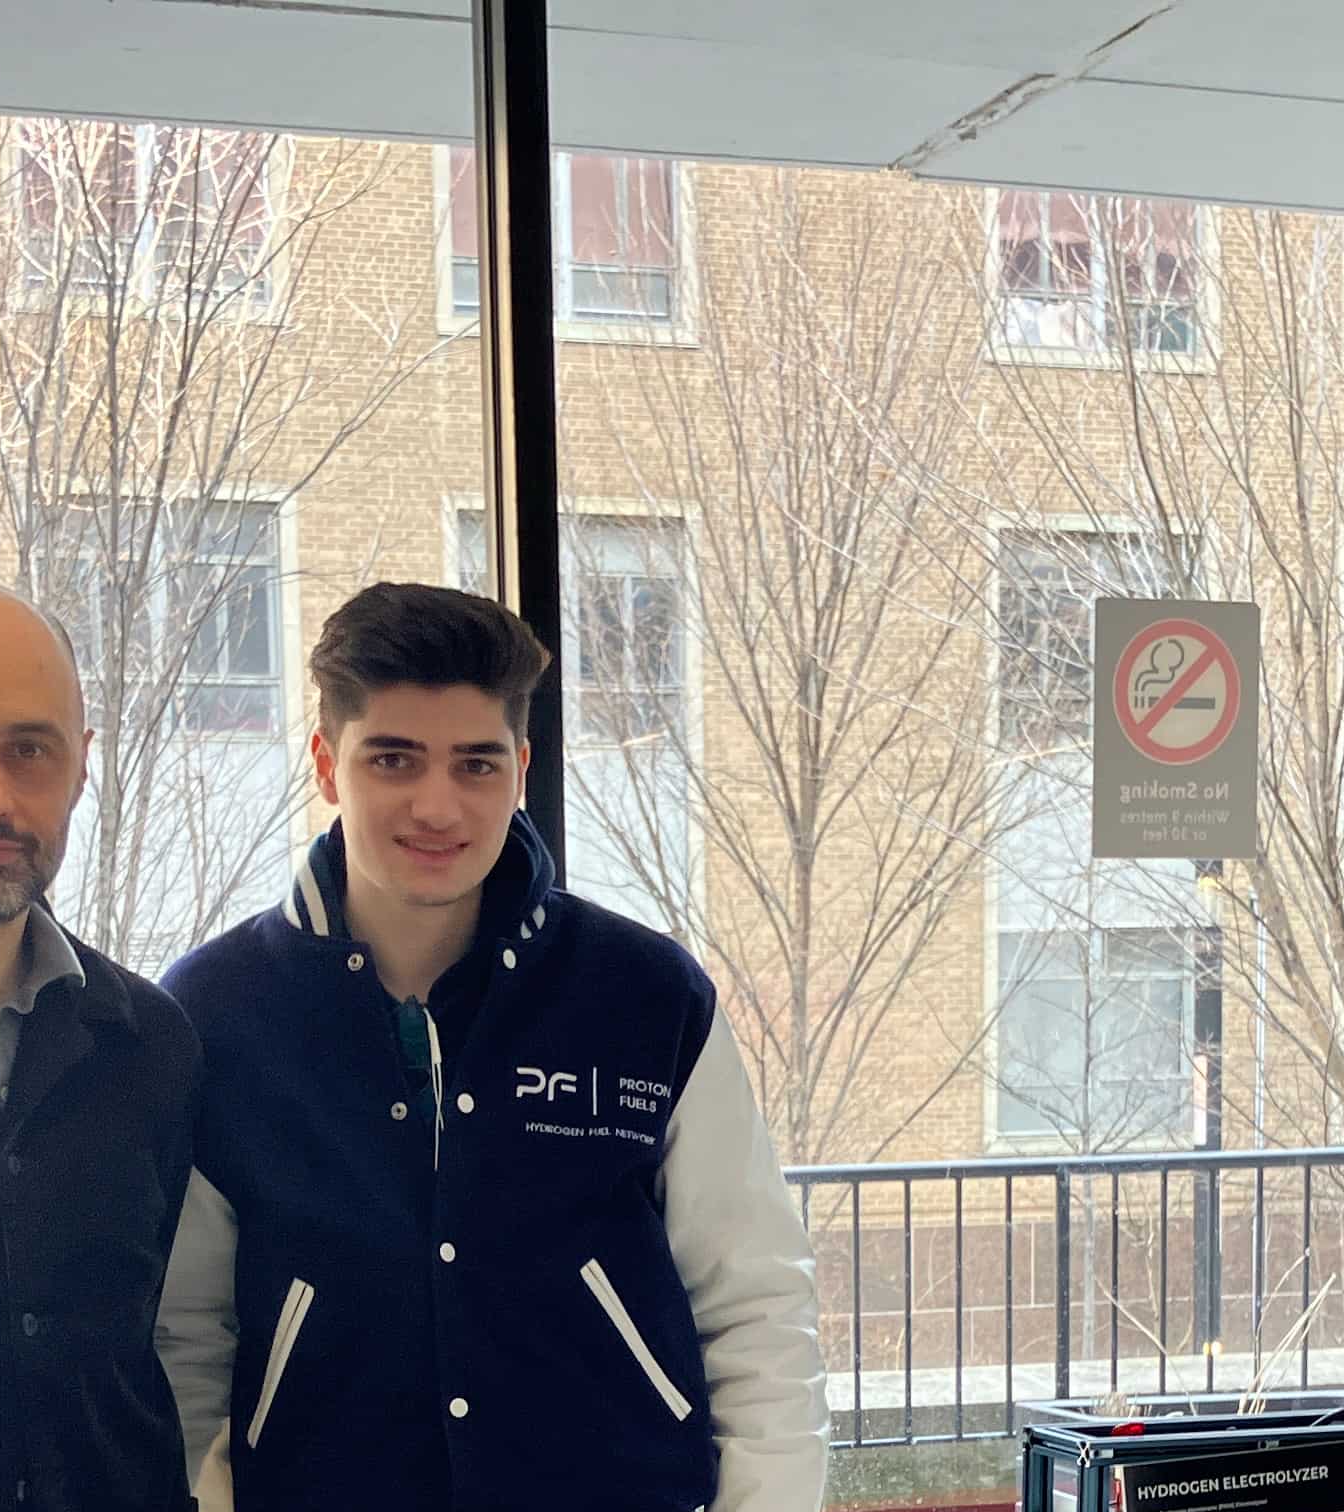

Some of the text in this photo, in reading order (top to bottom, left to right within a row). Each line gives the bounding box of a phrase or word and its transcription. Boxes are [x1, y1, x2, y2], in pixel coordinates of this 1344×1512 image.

[619, 1078, 671, 1099] PROTON
[619, 1096, 657, 1113] FUELS
[526, 1122, 656, 1146] HYDROGEN FUEL NETWORK
[1137, 1465, 1329, 1500] HYDROGEN ELECTROLYZER
